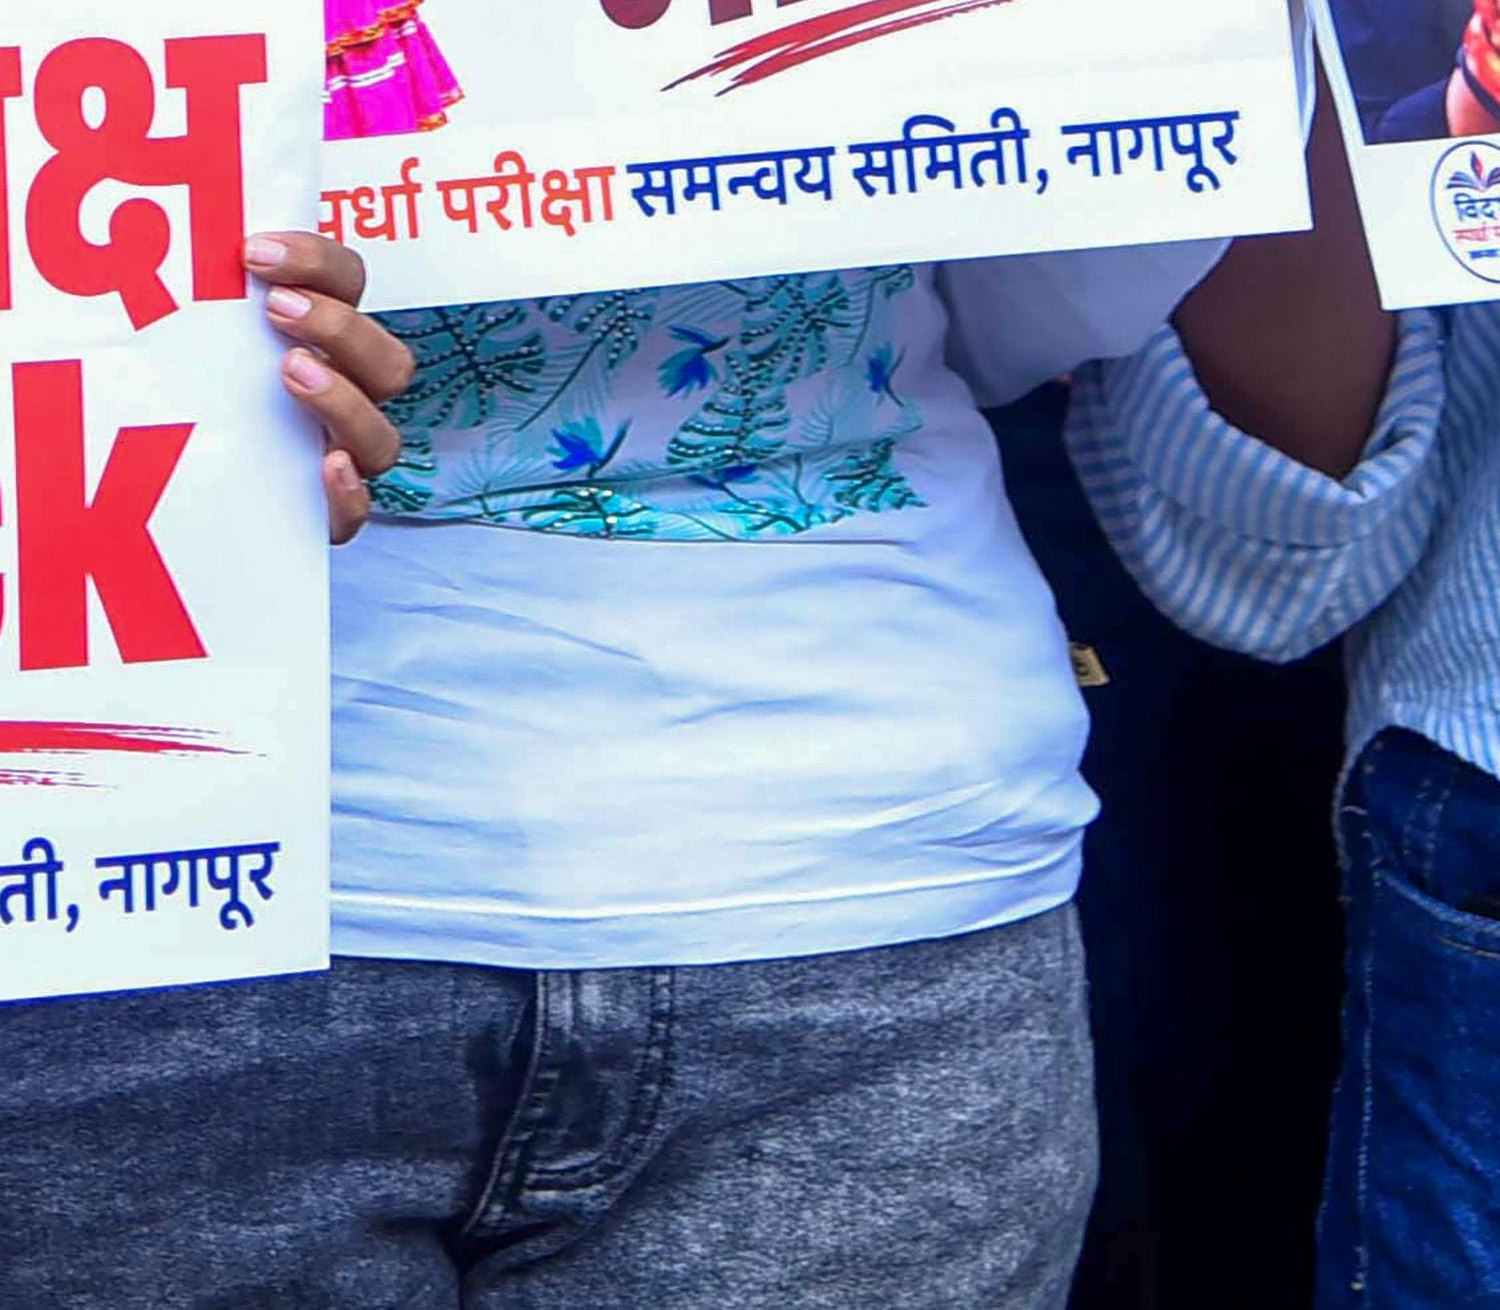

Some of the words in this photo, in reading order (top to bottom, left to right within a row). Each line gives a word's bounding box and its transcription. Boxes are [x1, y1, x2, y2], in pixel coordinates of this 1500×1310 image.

[436, 150, 618, 238] परीक्षा
[626, 148, 836, 218] समन्वय
[848, 106, 1050, 196] समिती,
[1060, 110, 1240, 192] नागपूर
[95, 841, 282, 930] नागपूर
